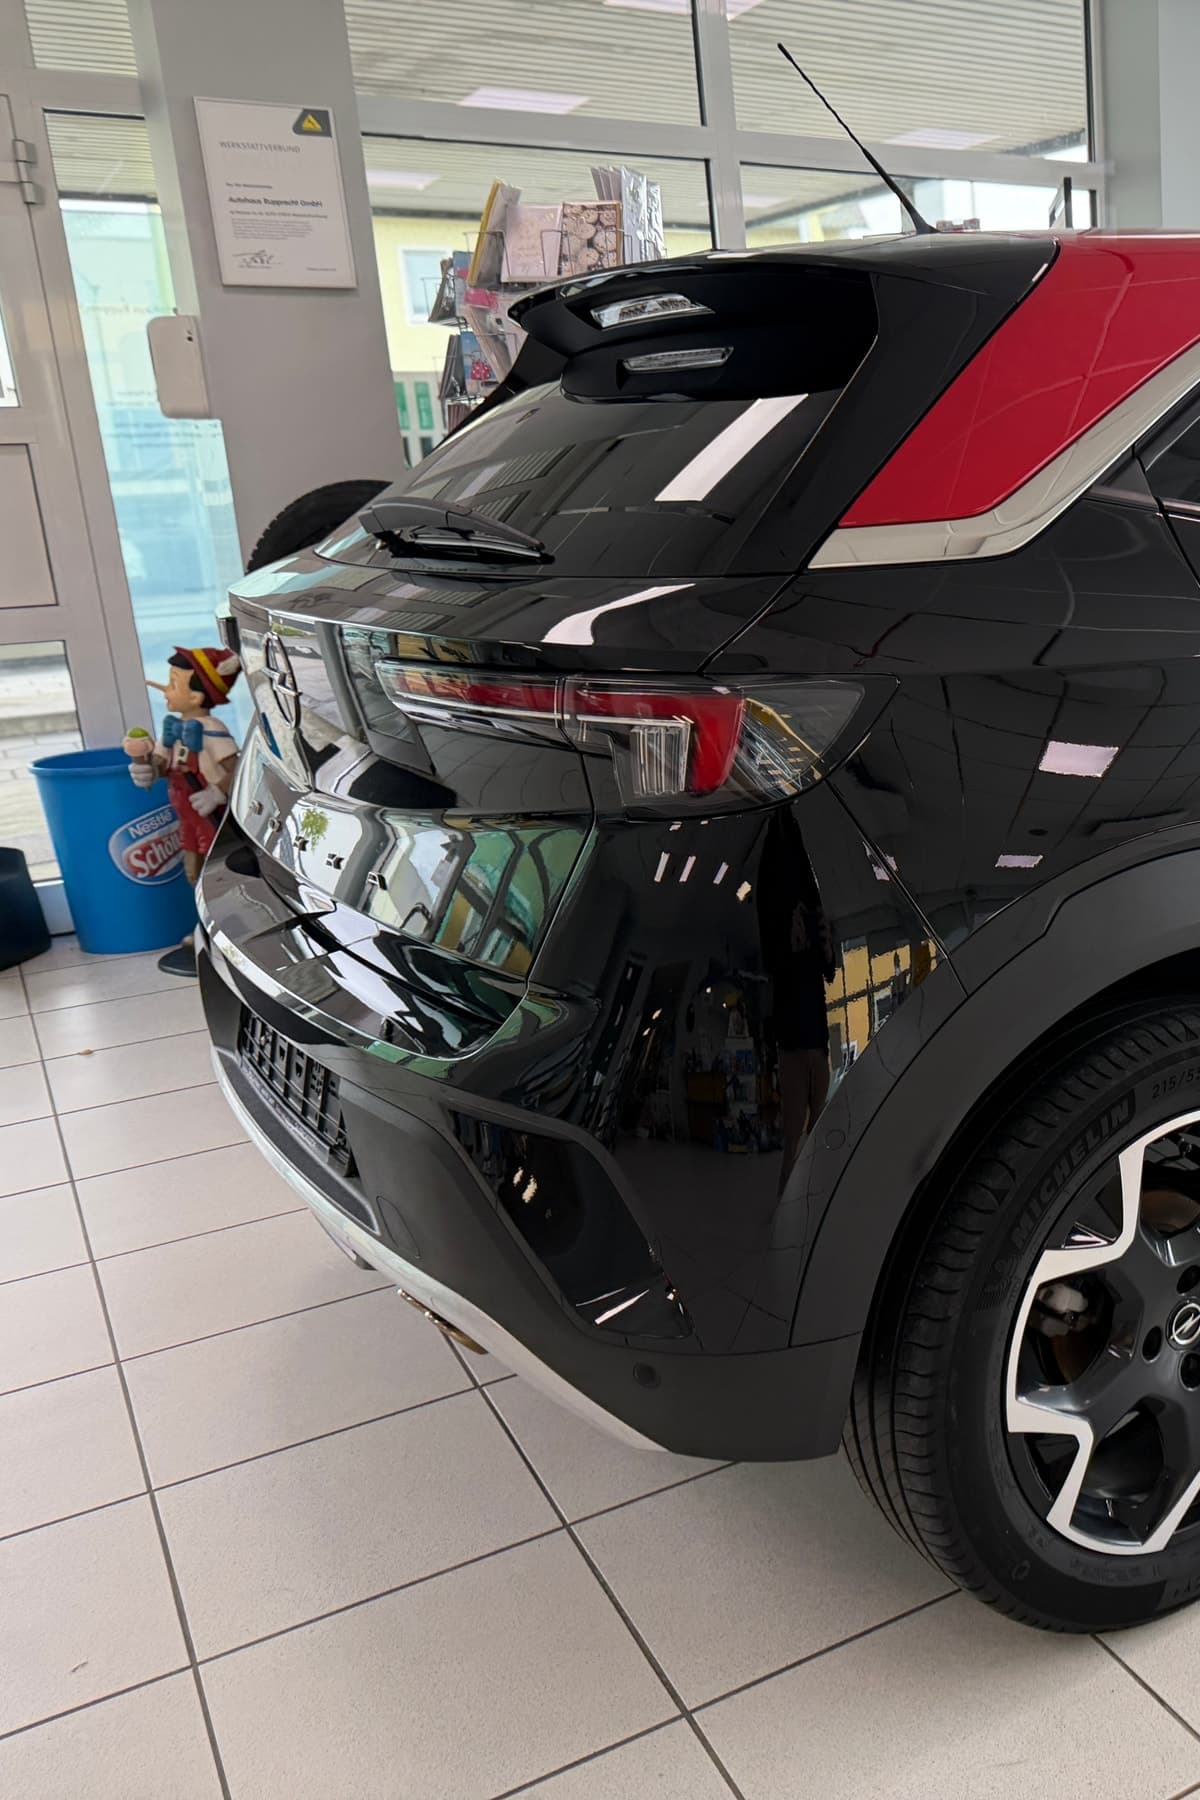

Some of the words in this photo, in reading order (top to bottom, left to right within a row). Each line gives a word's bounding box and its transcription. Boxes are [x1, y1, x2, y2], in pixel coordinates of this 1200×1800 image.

[219, 141, 301, 153] WERKSTATTVERBUND
[228, 196, 262, 205] Autohaus
[263, 198, 299, 207] Rupprecht
[300, 199, 323, 208] GmbH
[128, 809, 173, 839] Nestlé
[1011, 1097, 1131, 1250] MICHELIN
